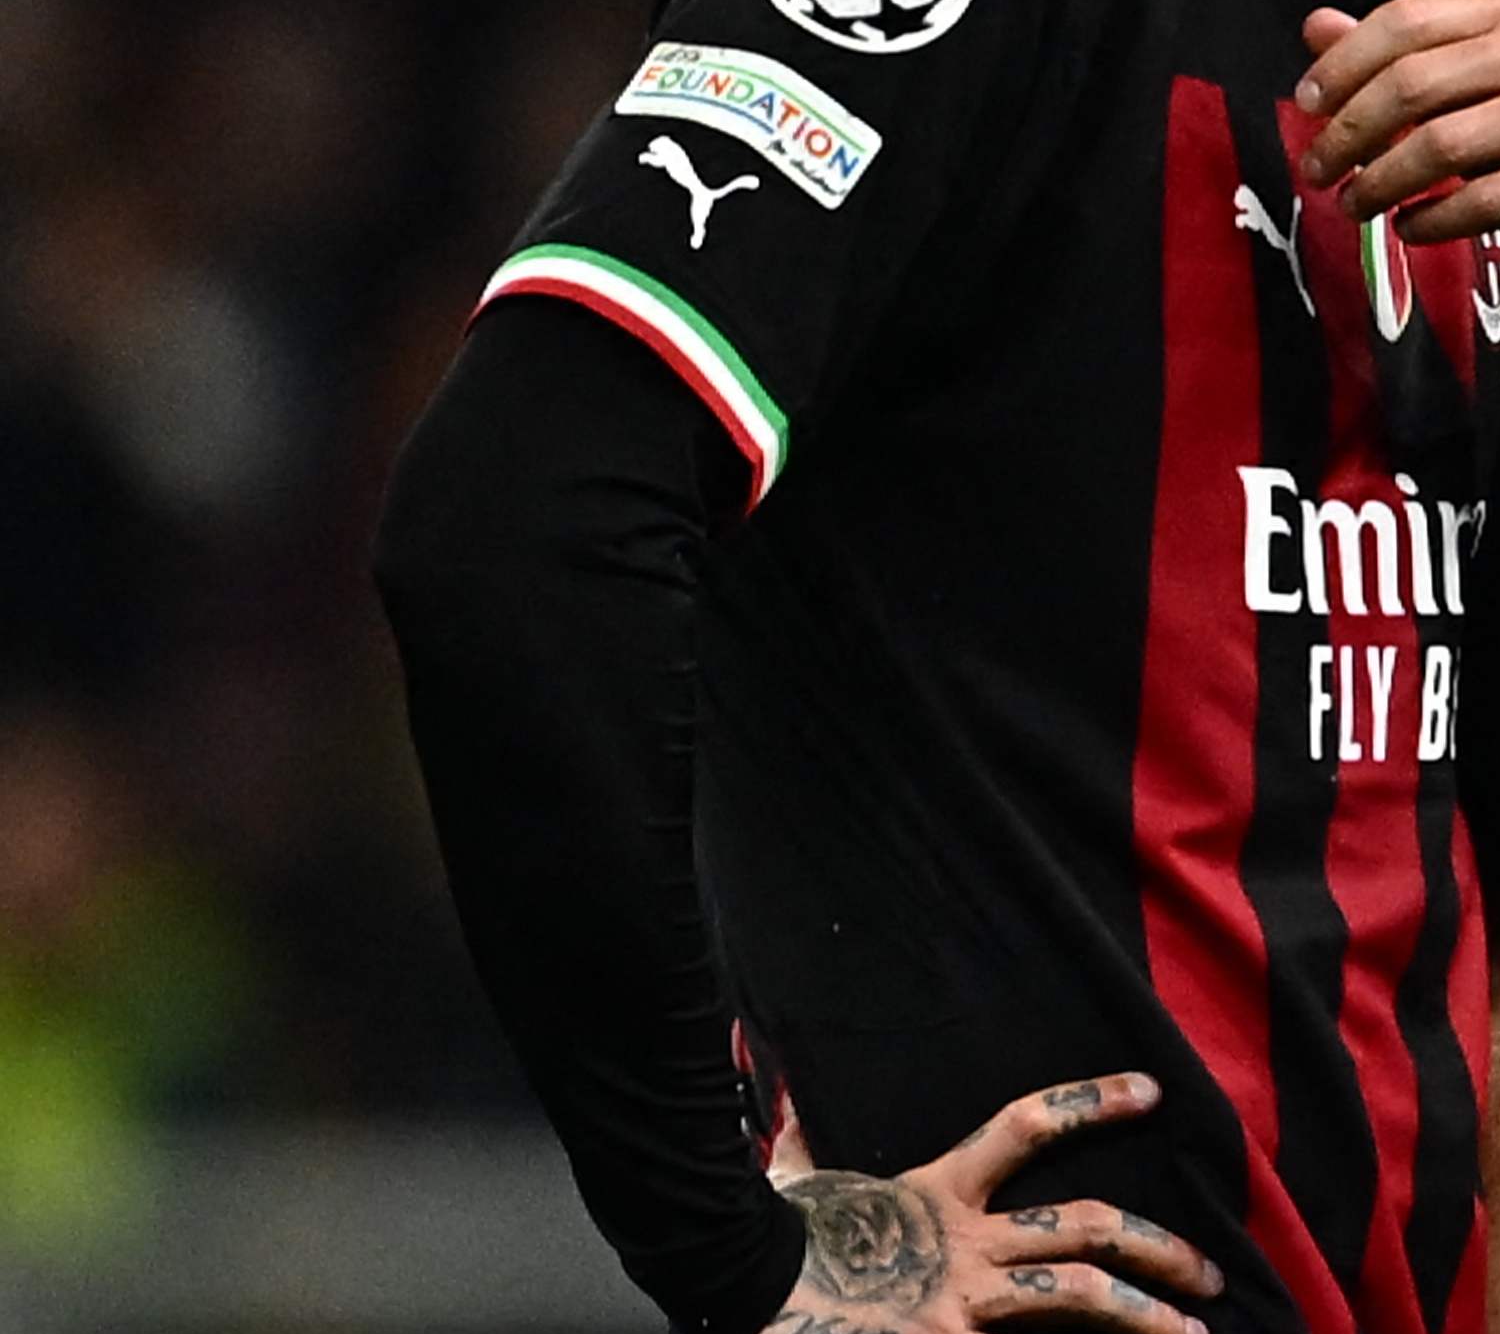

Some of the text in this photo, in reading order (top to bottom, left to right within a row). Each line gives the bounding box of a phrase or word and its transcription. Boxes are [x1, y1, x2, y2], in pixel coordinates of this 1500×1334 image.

[638, 65, 859, 179] FOUNDATION
[1236, 465, 1486, 616] Emir
[1309, 644, 1398, 762] FLY
